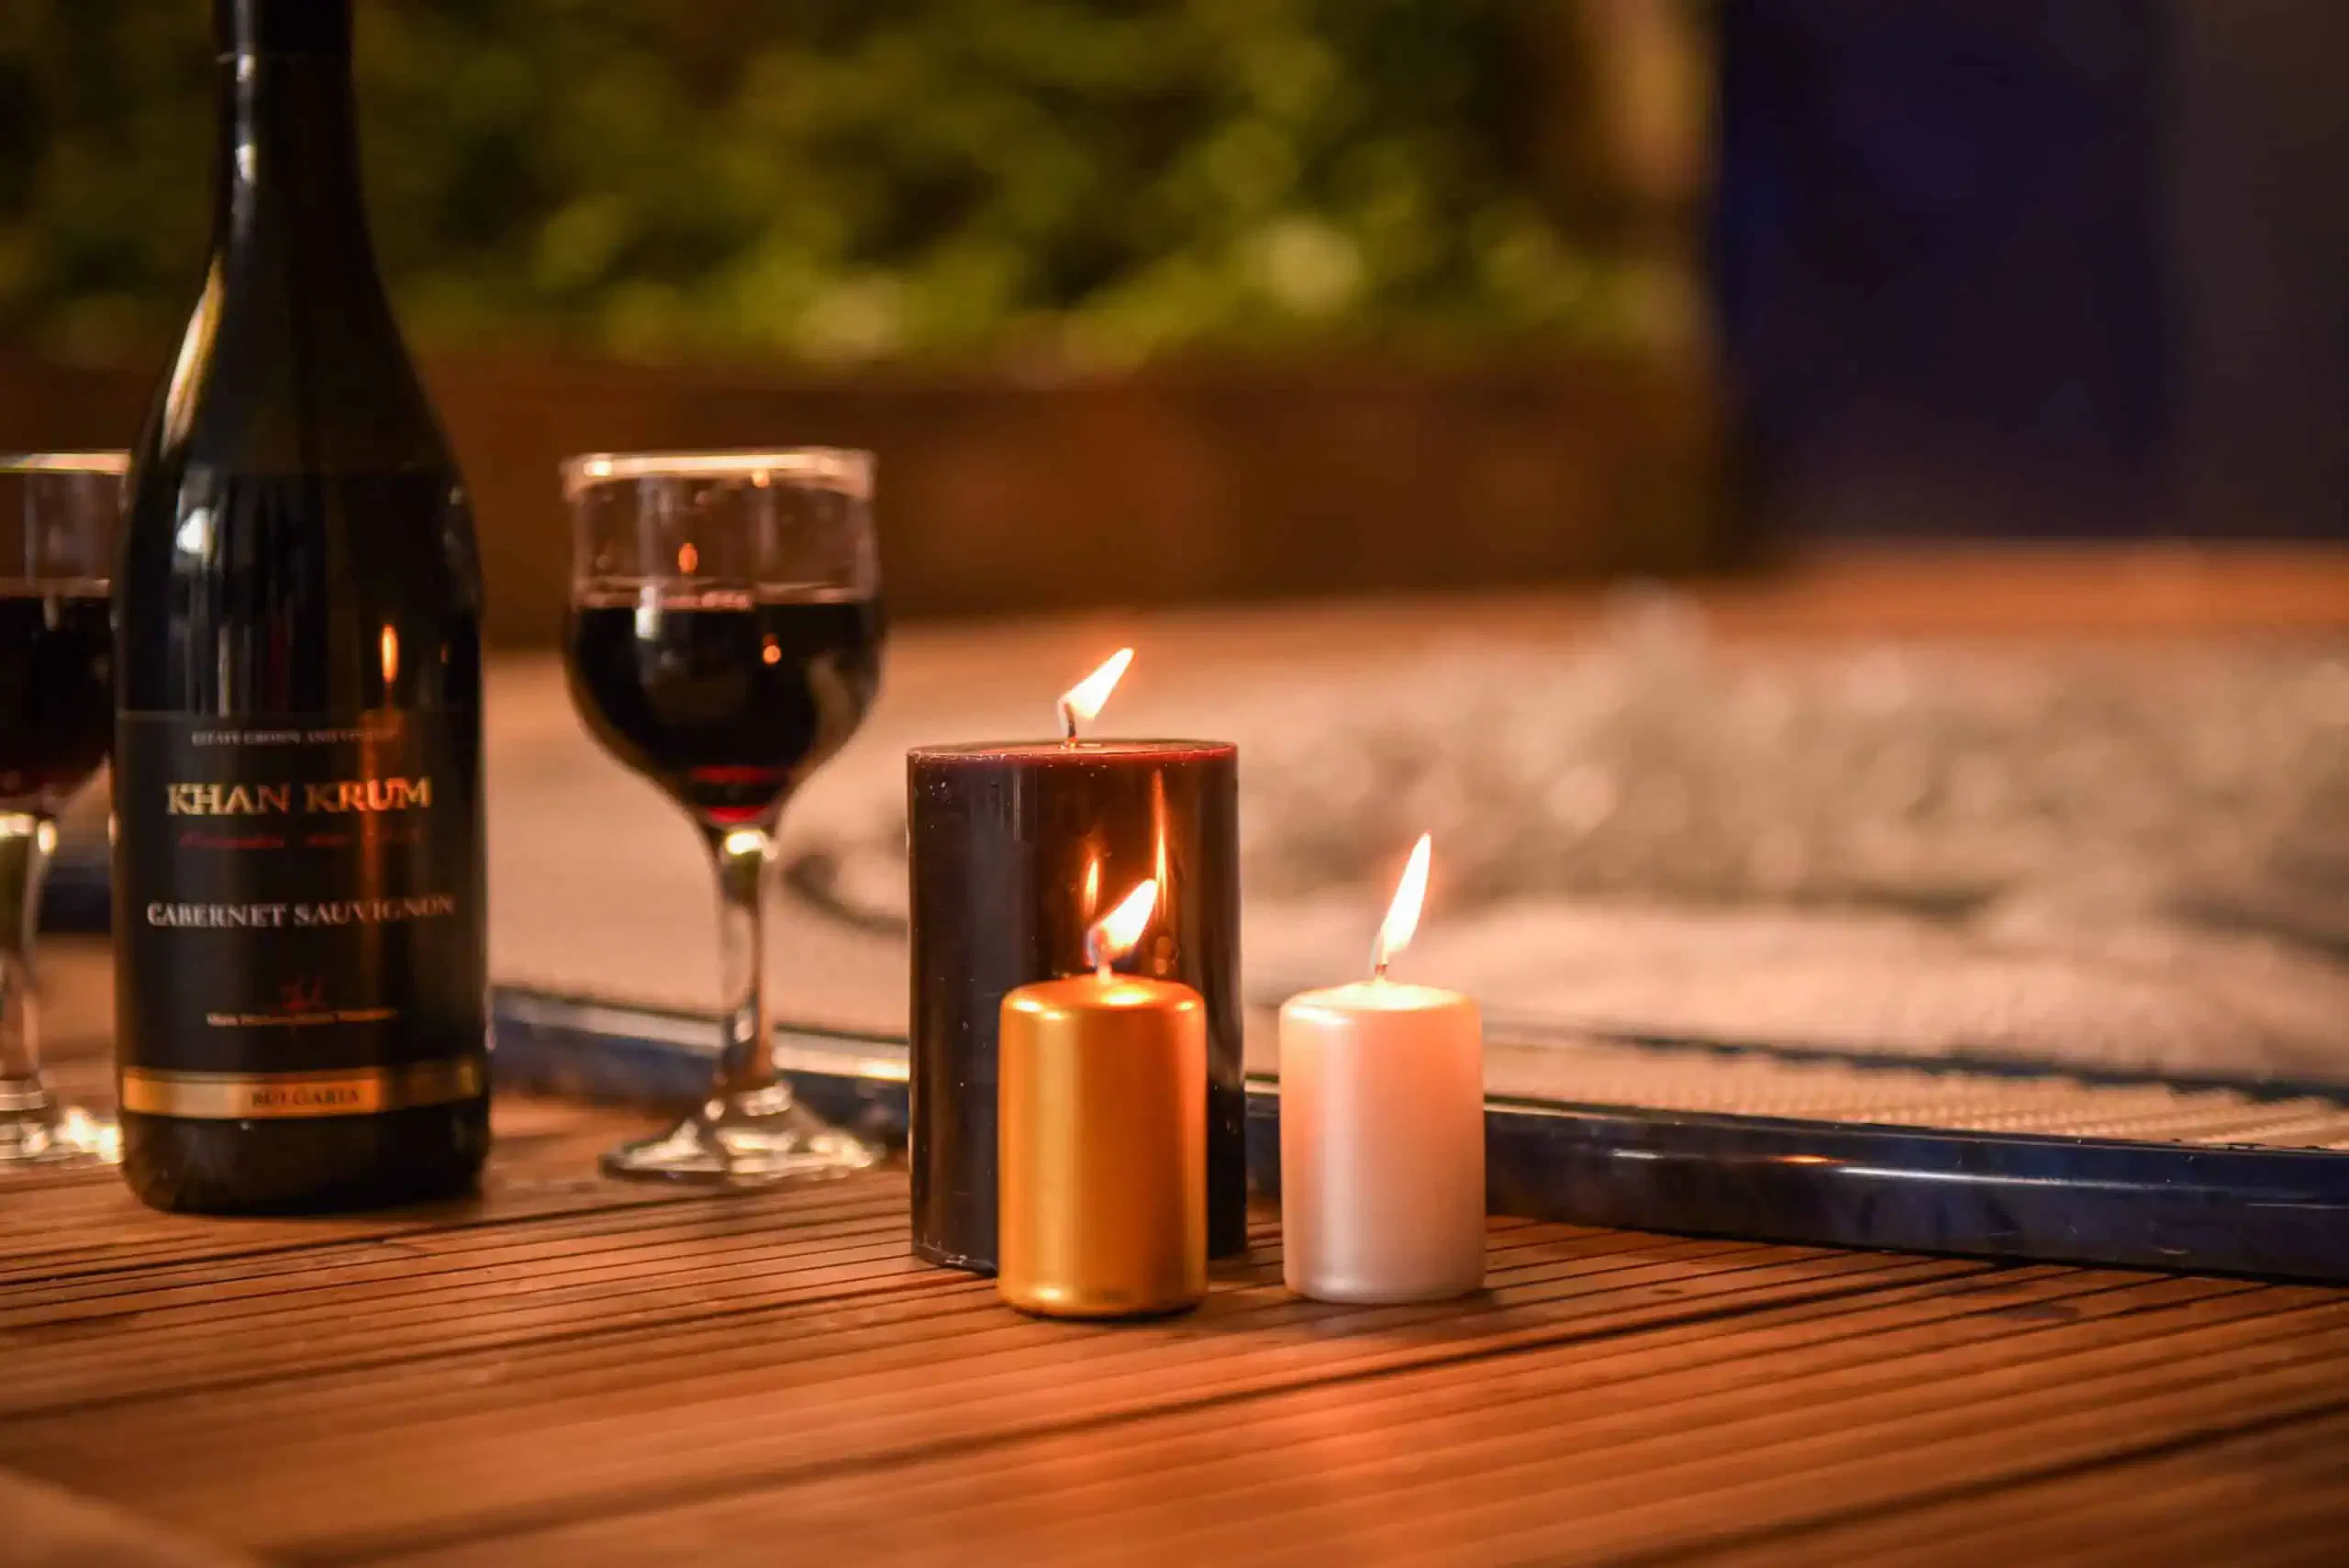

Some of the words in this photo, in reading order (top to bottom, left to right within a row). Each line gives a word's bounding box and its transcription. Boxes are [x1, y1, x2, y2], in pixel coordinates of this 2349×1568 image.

[166, 784, 291, 816] KHAN
[305, 777, 432, 812] KRUM
[147, 902, 286, 929] CABERNET
